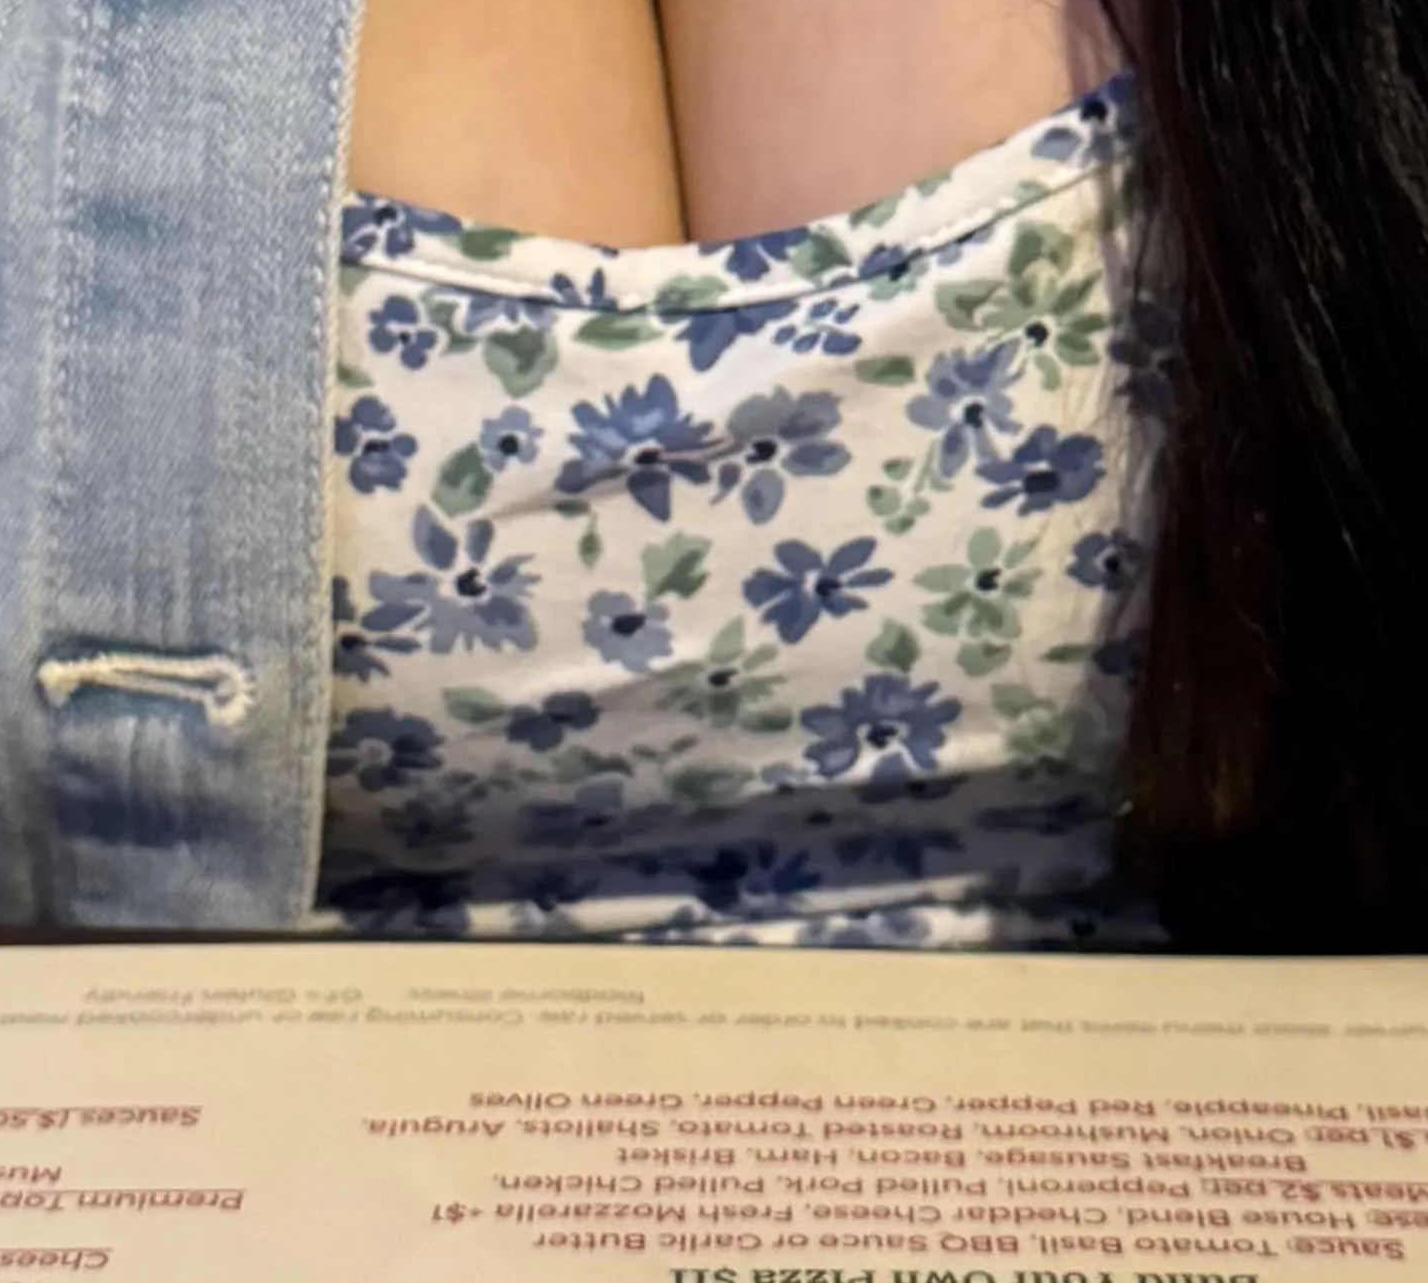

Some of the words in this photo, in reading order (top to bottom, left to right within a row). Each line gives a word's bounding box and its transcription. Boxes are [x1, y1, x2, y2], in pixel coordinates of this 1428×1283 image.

[468, 1092, 571, 1110] Olives
[581, 1092, 683, 1110] Green
[834, 1096, 936, 1114] Green
[946, 1095, 1078, 1116] Pepper,
[1090, 1099, 1155, 1116] Red
[79, 1106, 202, 1128] Sauces
[361, 1116, 506, 1138] Arugula,
[516, 1118, 660, 1138] Shallots,
[670, 1118, 808, 1138] Tomato,
[824, 1123, 963, 1141] Roasted
[974, 1123, 1169, 1143] Mushroom,
[1181, 1125, 1296, 1144] Onion,
[1381, 1130, 1418, 1152] $1
[616, 1147, 735, 1166] Brisket
[747, 1147, 838, 1166] Ham,
[850, 1147, 966, 1167] Bacon,
[977, 1148, 1131, 1168] Sausage,
[1143, 1153, 1307, 1173] Breakfast
[491, 1174, 643, 1194] Chicken,
[654, 1176, 765, 1194] Pulled
[776, 1175, 864, 1194] Pork,
[876, 1178, 987, 1196] Pulled
[998, 1177, 1190, 1197] Pepperoni,
[1280, 1181, 1322, 1204] $2
[76, 1189, 246, 1211] Premium
[495, 1204, 687, 1222] Mozzarella
[699, 1204, 794, 1222] Fresh
[805, 1204, 942, 1224] Cheese,
[953, 1206, 1108, 1225] Cheddar
[1116, 1207, 1230, 1227] Blend,
[1242, 1210, 1355, 1228] House
[532, 1233, 646, 1251] Butter
[658, 1233, 762, 1251] Garlic
[775, 1234, 808, 1249] or
[819, 1234, 928, 1253] Sauce
[939, 1234, 1018, 1253] BBQ
[1028, 1234, 1123, 1255] Basil,
[1134, 1236, 1278, 1257] Tomato
[752, 1269, 875, 1283] Pizza
